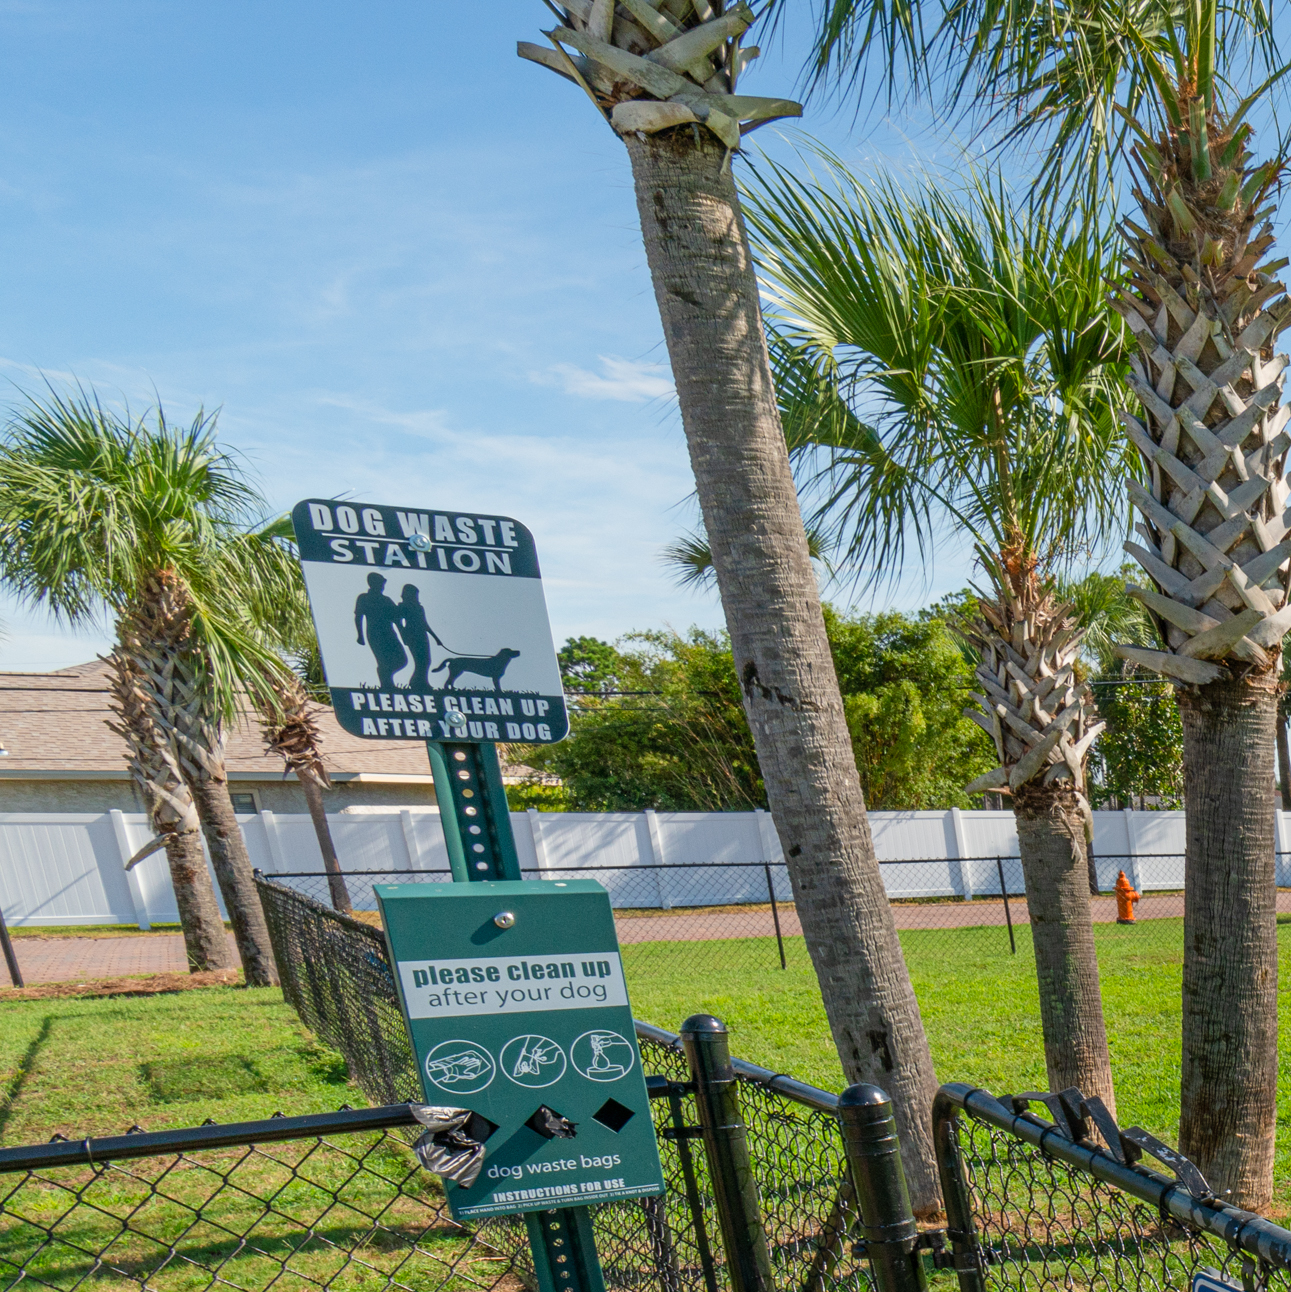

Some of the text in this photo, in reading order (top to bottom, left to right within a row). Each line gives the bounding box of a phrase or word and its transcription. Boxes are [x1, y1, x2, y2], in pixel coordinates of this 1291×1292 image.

[308, 502, 519, 548] DOG WASTE
[330, 538, 513, 575] STATION
[350, 692, 550, 717] PLEASE CLEAN UP
[362, 717, 552, 741] AFTER YOUR DOG
[413, 960, 612, 988] please clean up
[428, 981, 607, 1008] after your dog
[487, 1153, 621, 1180] dog waste bags
[493, 1178, 626, 1203] INSTRUCTIONS FOR USE
